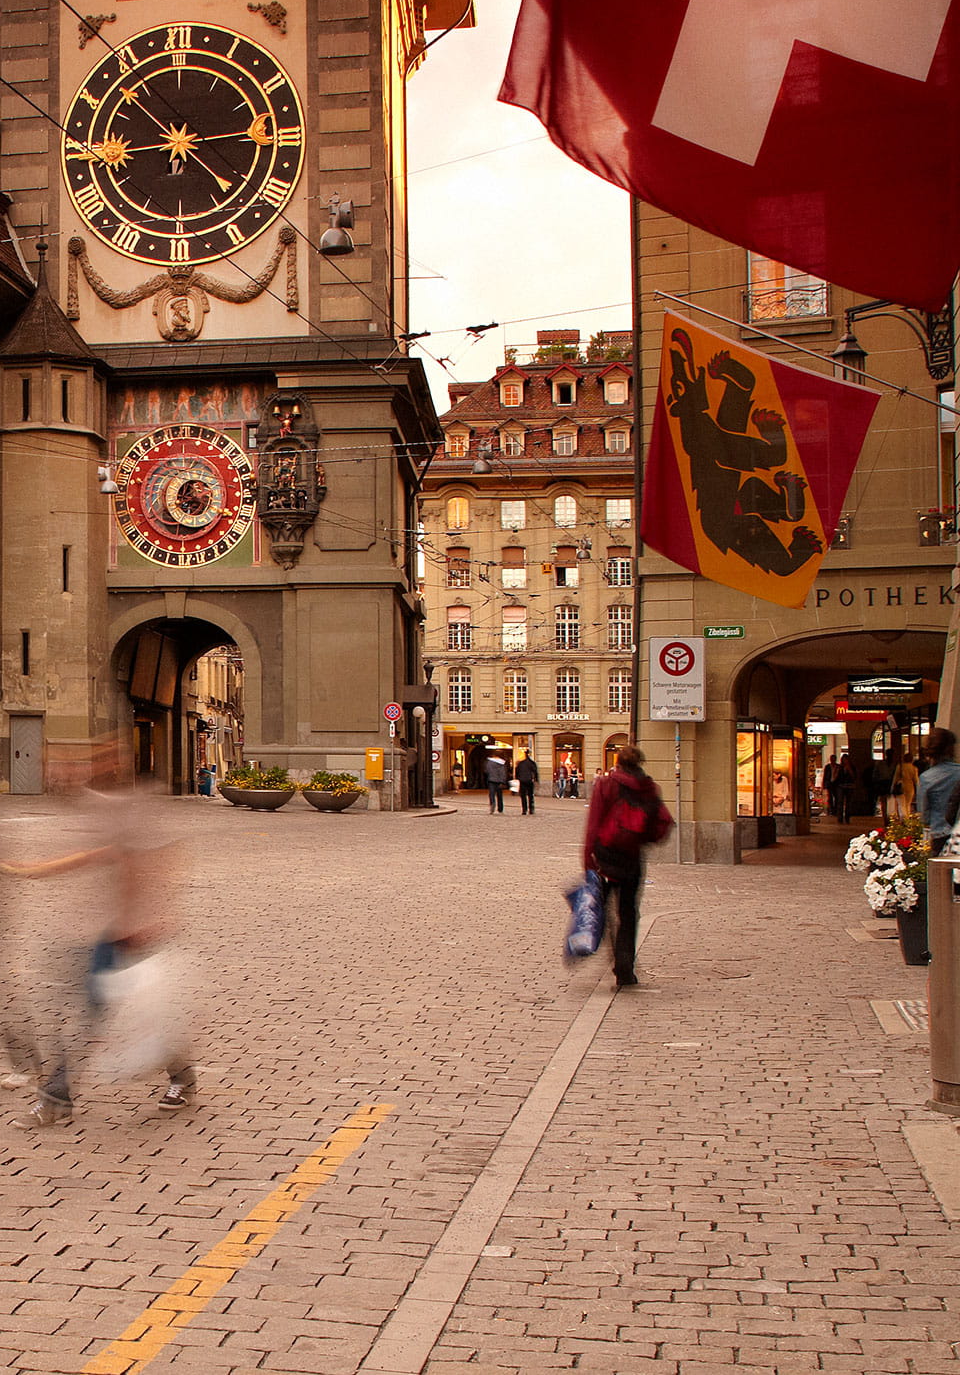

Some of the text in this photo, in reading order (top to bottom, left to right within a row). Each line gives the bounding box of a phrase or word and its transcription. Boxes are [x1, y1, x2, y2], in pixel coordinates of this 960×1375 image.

[164, 26, 192, 50] XII
[227, 37, 240, 59] I
[117, 45, 139, 73] XI
[263, 71, 285, 94] II
[80, 88, 100, 110] X
[278, 126, 301, 146] III
[74, 183, 104, 220] VIII
[261, 177, 290, 206] IIII
[112, 224, 141, 252] VII
[226, 223, 245, 245] V
[170, 239, 190, 261] VI
[804, 585, 954, 607] POTHEK
